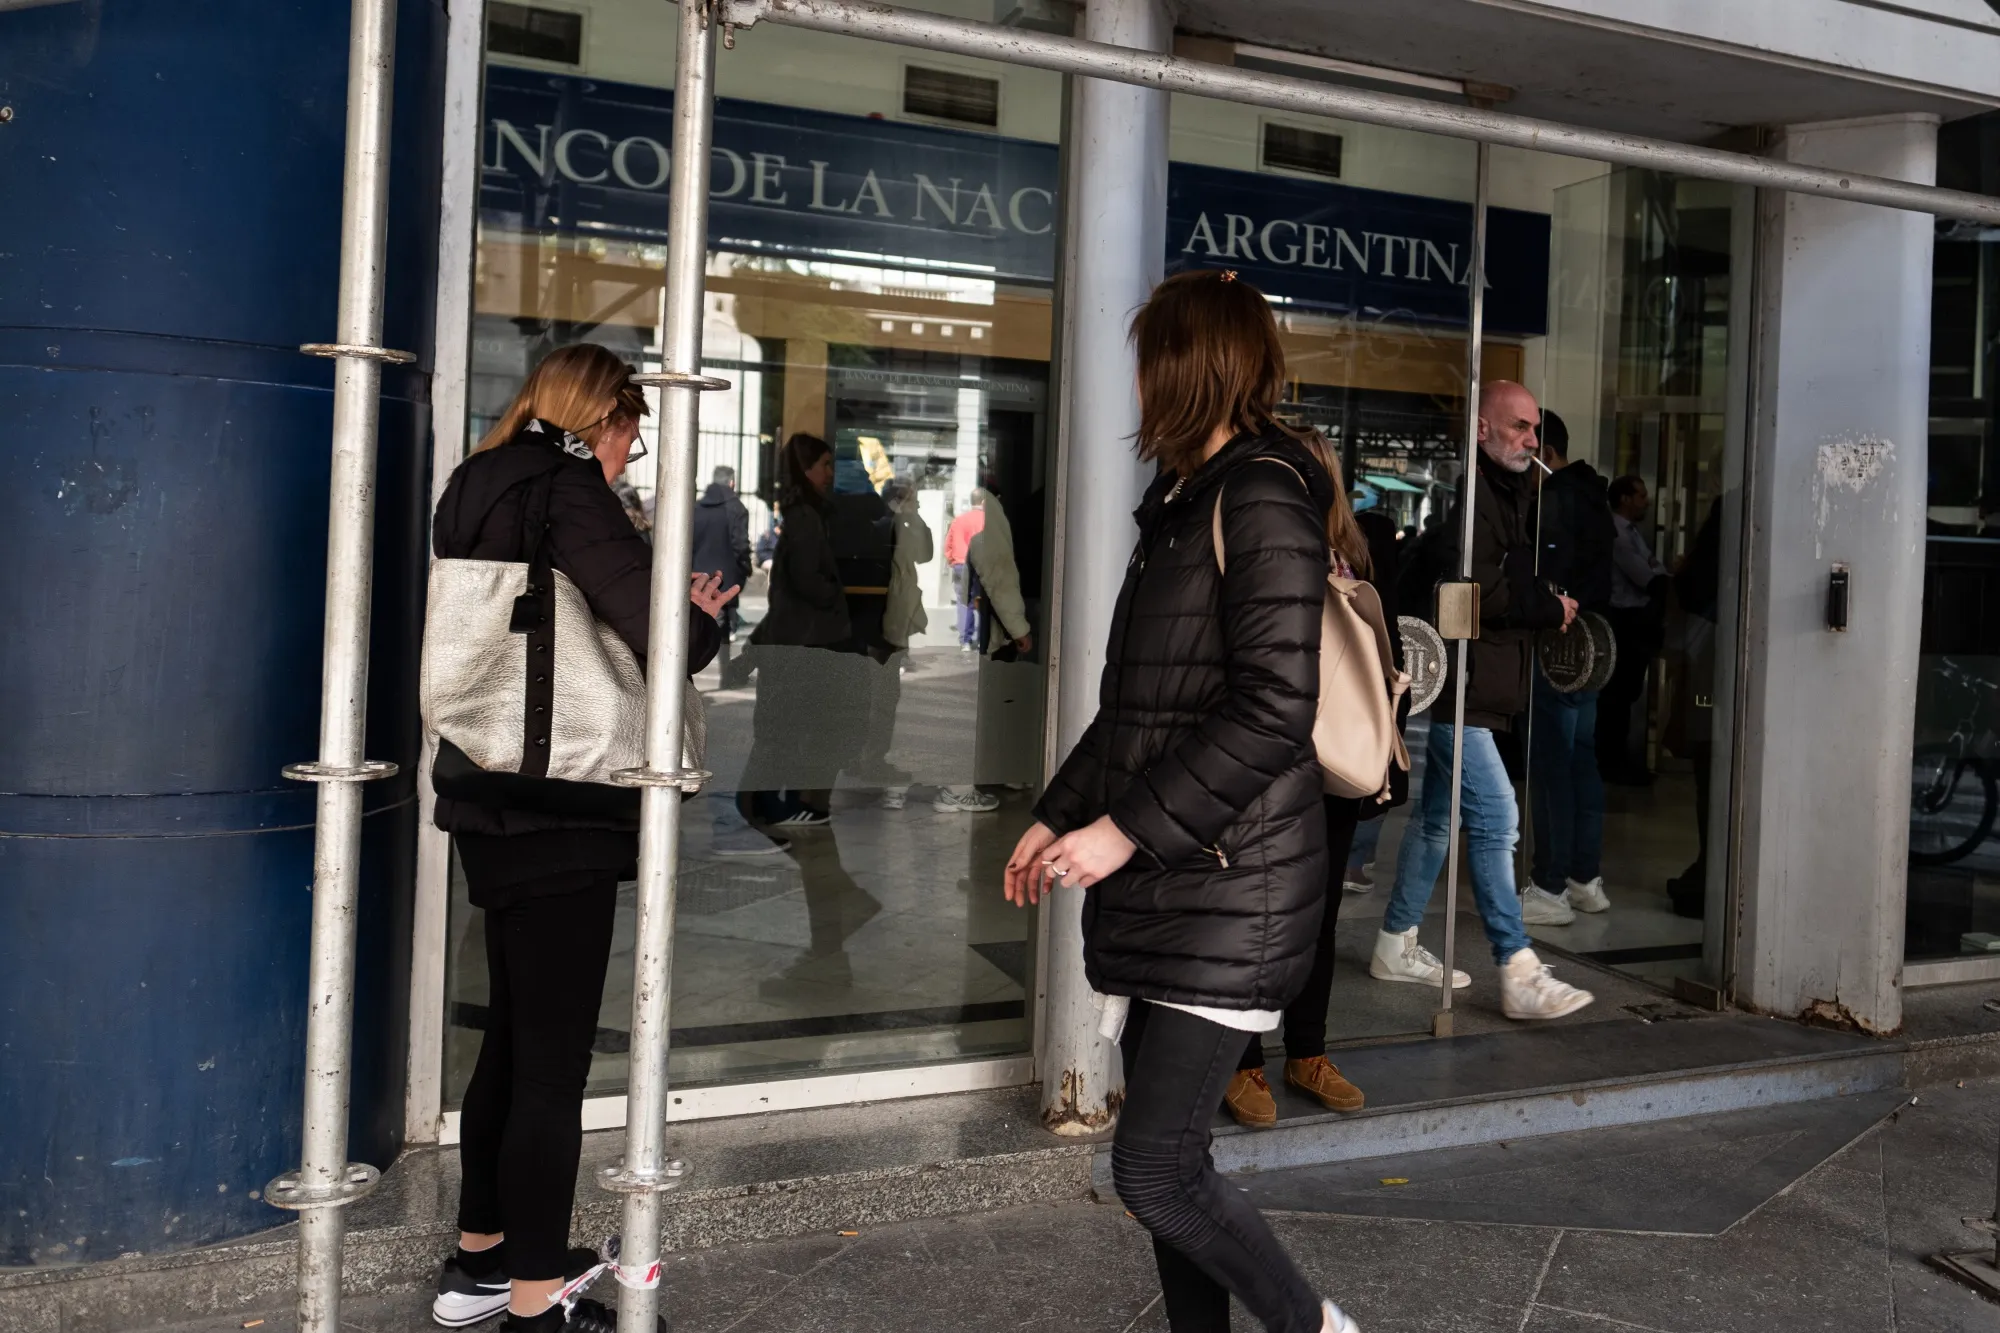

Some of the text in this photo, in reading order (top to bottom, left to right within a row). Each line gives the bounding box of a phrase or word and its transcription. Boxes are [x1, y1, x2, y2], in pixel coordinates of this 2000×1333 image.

[482, 118, 671, 190] NCO
[805, 160, 893, 218] LA
[844, 370, 885, 382] BANCO
[970, 380, 1030, 394] ARGENTINA
